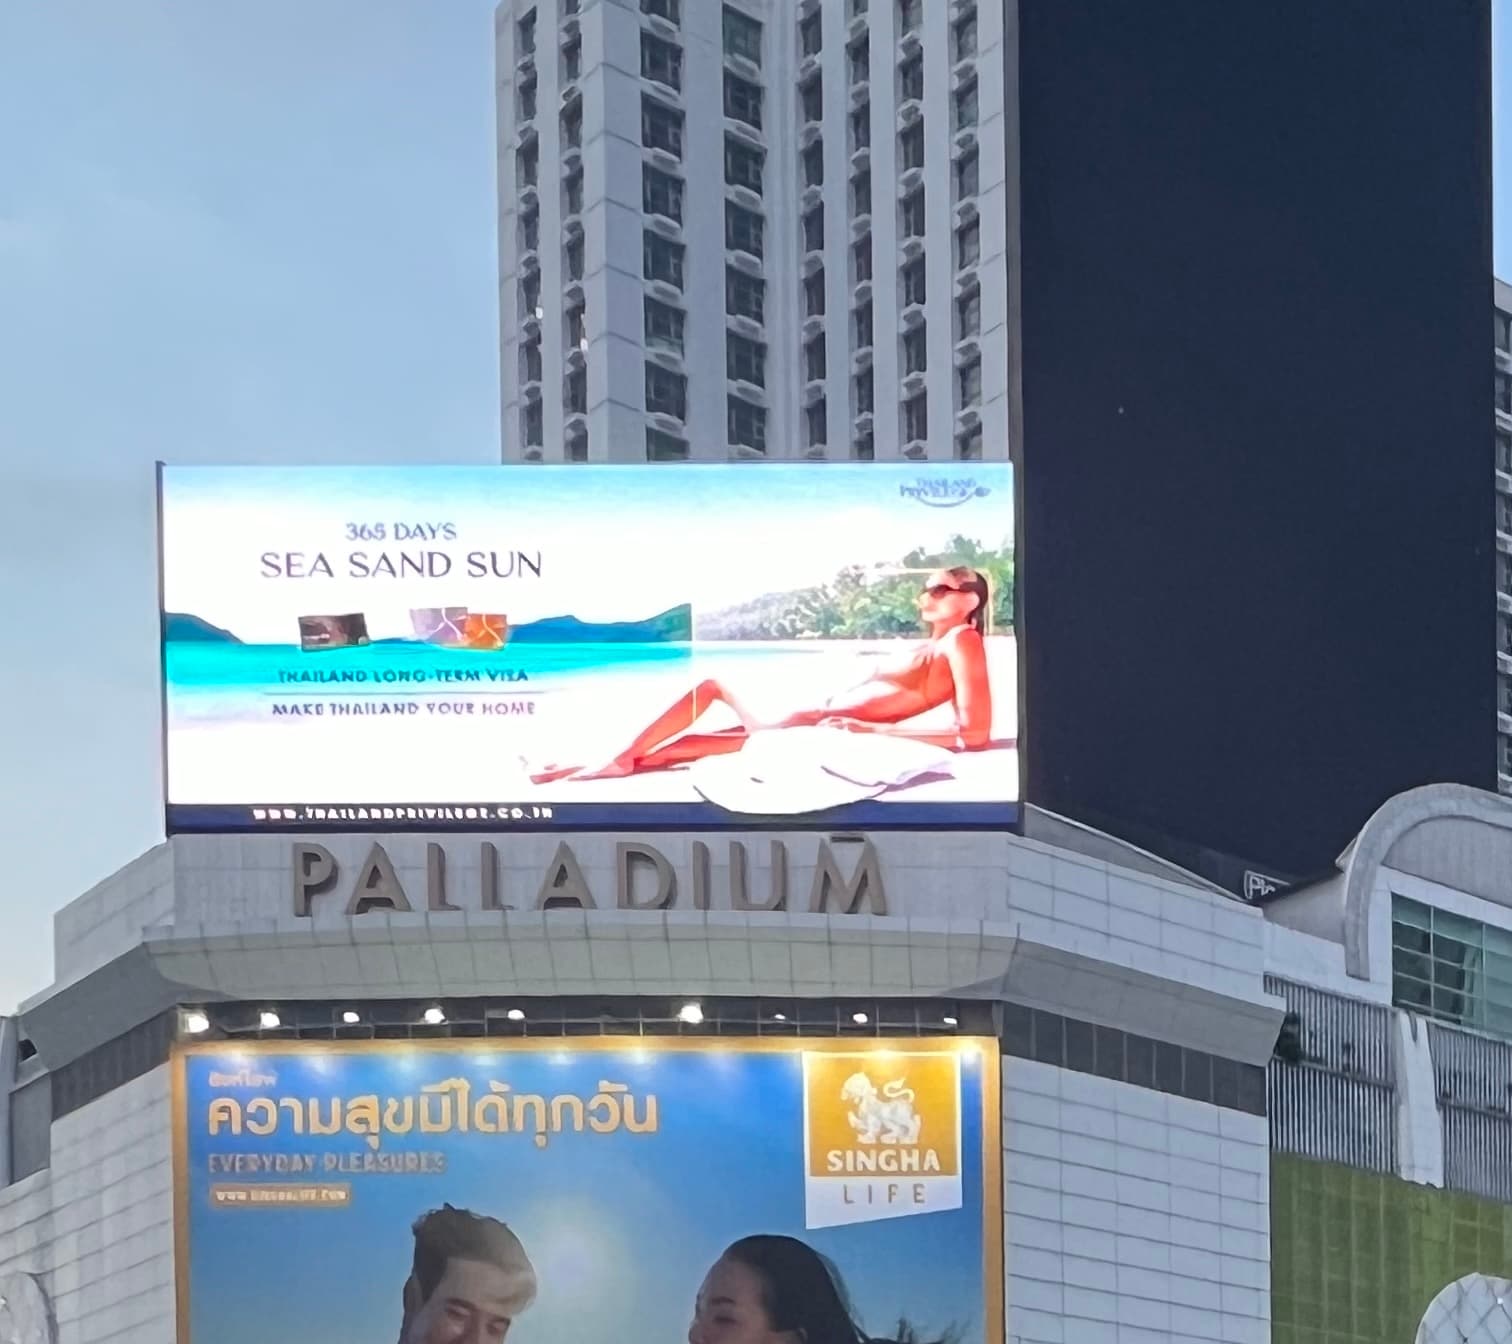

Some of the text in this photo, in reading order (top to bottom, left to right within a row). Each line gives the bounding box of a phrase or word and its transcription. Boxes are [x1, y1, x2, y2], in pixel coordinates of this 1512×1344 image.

[345, 523, 457, 541] 365 DAYS
[260, 550, 543, 578] SEA SAND SUN
[278, 669, 369, 683] THAILAND
[272, 702, 535, 716] MAKE THAILAND YOUR HOME
[291, 834, 889, 918] PALLADIUM
[208, 1076, 659, 1150] ความสุขมีได้ทุกวัน
[209, 1153, 447, 1173] EVERYDAY PLEASURES
[826, 1149, 940, 1172] SINGHA
[843, 1184, 926, 1205] LIFE
